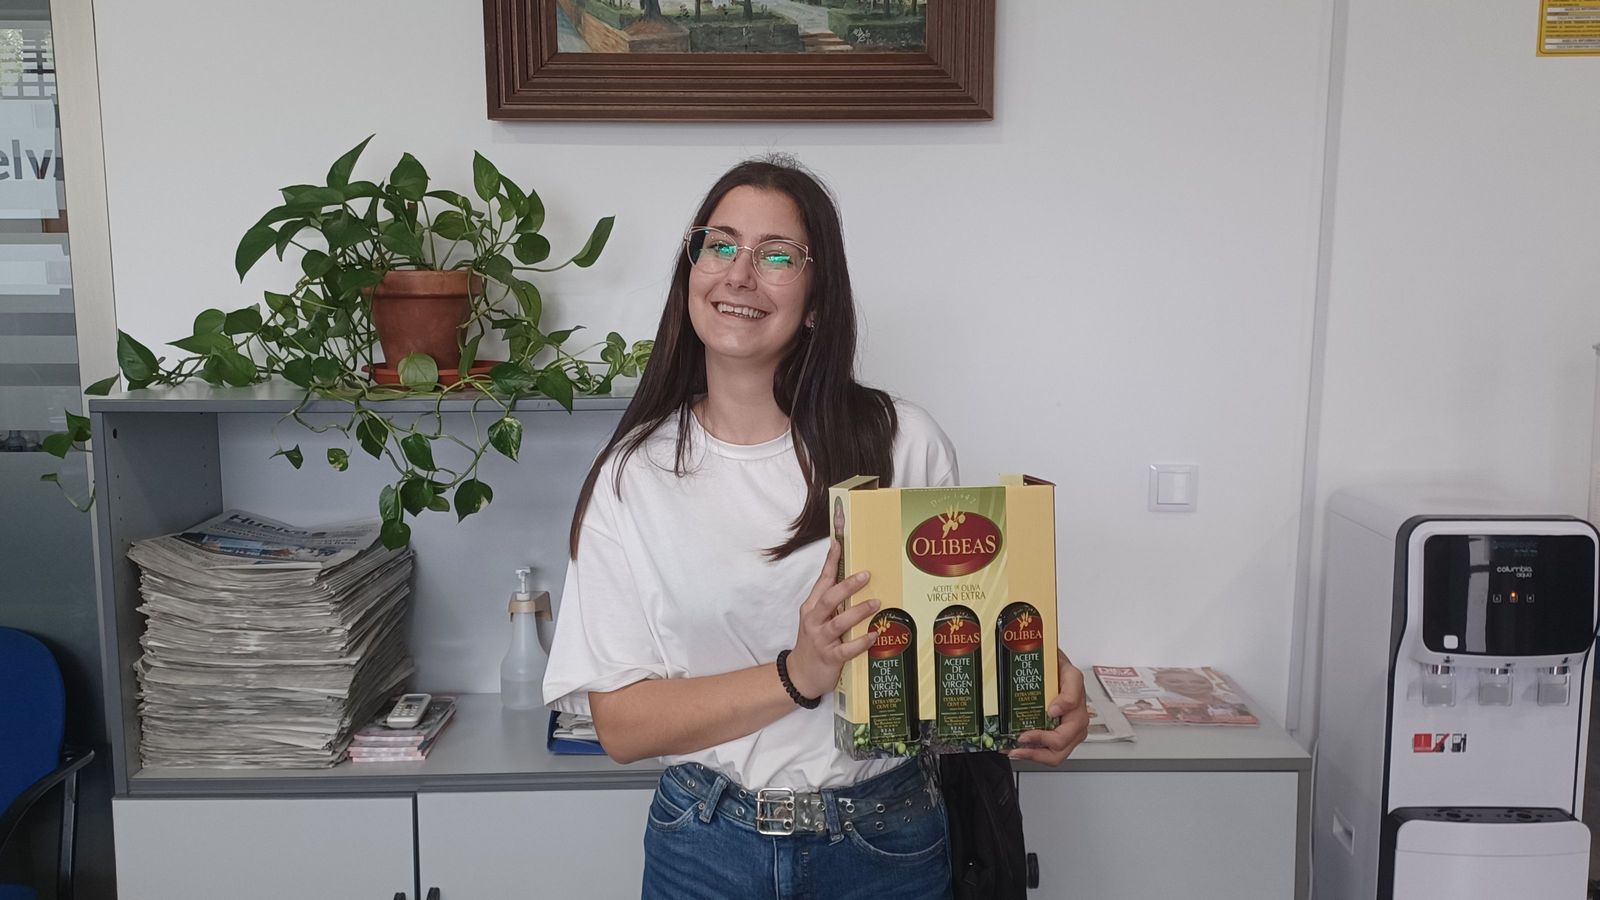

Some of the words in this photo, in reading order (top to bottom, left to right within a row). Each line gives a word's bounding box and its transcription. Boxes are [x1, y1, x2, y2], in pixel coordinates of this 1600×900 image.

[0, 139, 55, 181] elv
[912, 534, 996, 557] OLIBEAS
[1497, 565, 1533, 574] columbia
[932, 585, 953, 593] ACEITE
[961, 584, 981, 592] OLIVA
[927, 592, 959, 602] VIRGEN
[961, 591, 986, 601] EXTRA
[874, 633, 910, 646] IBEAS
[934, 632, 980, 645] OLIBEAS
[1004, 629, 1042, 642] OLIBEA
[944, 657, 971, 666] ACEITE
[1014, 653, 1039, 663] ACEITE
[872, 659, 900, 669] ACEITE
[1021, 661, 1032, 669] DE
[880, 667, 892, 676] DE
[952, 665, 963, 674] DE
[1015, 668, 1039, 677] OLIVA
[873, 674, 899, 684] OLIVA
[945, 672, 970, 681] OLIVA
[1012, 675, 1042, 684] VIRGEN
[870, 682, 902, 691] VIRGEN
[942, 680, 973, 689] VIRGEN
[1016, 683, 1040, 692] EXTRA
[874, 689, 900, 698] EXTRA
[945, 688, 970, 696] EXTRA
